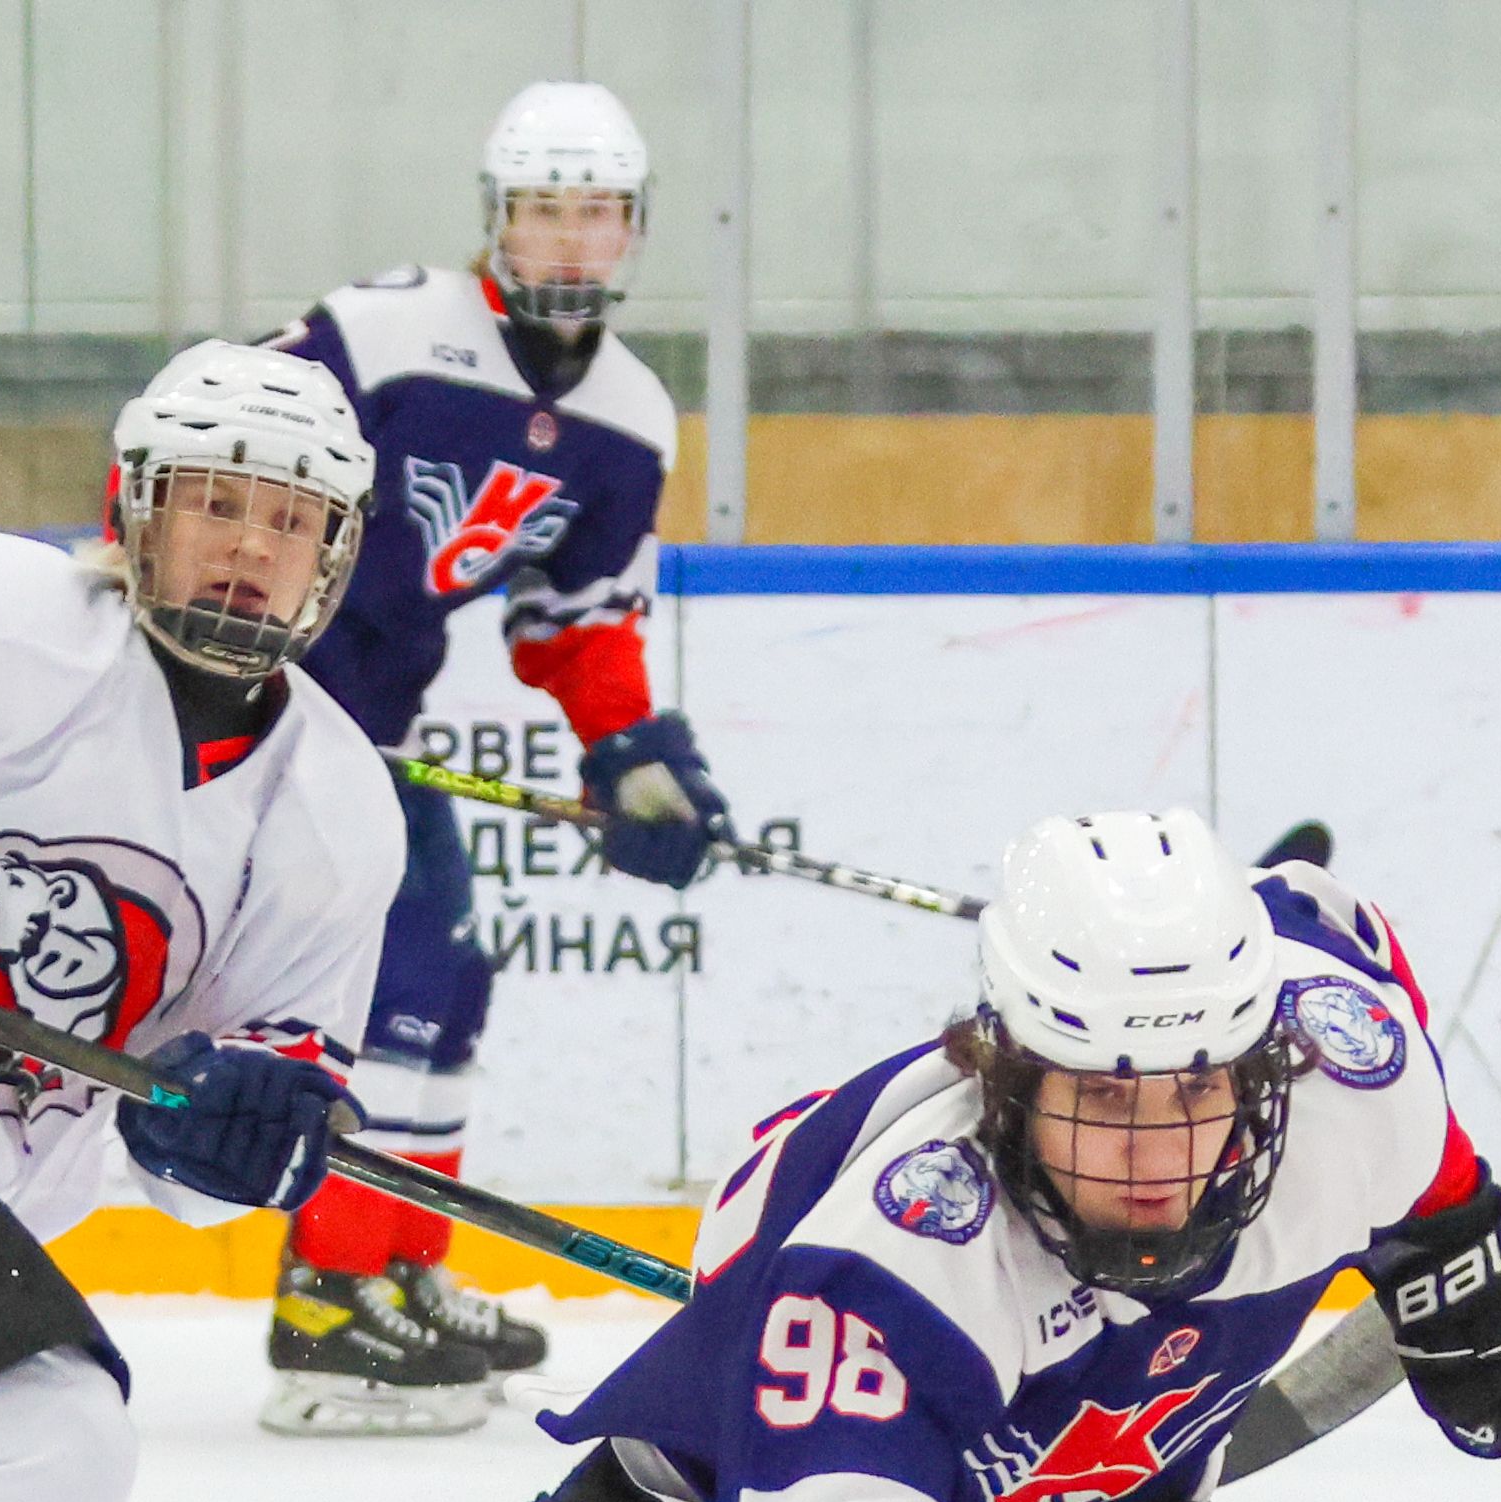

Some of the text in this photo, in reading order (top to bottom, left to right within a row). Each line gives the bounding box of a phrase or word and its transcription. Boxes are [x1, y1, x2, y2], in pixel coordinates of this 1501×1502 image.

[419, 722, 562, 779] РВЕ
[491, 893, 703, 973] ЙНАЯ
[1123, 1009, 1206, 1030] CCM
